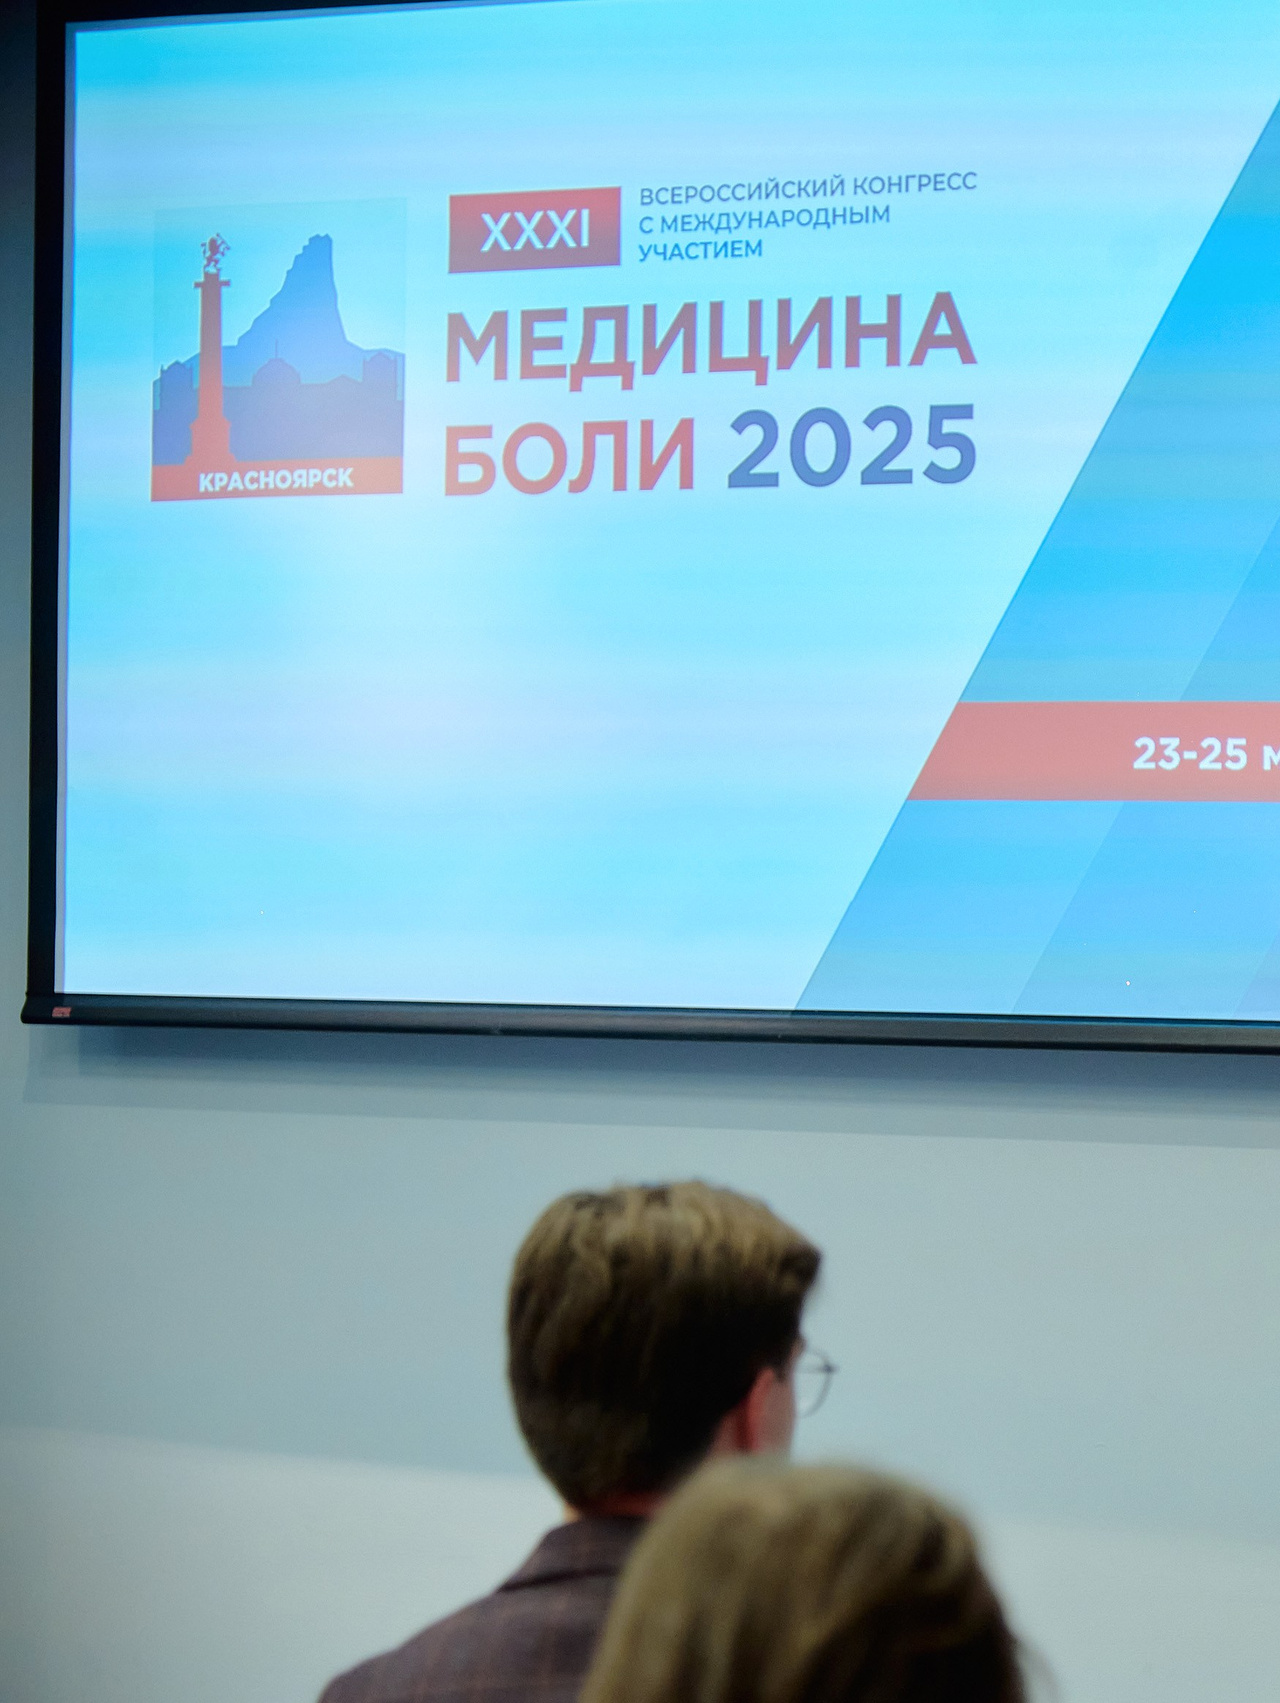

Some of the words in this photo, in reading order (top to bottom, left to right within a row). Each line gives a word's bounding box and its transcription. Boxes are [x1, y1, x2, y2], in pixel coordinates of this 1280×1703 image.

[640, 174, 846, 206] ВСЕРОССИЙСКИЙ
[853, 171, 978, 196] КОНГРЕСС
[479, 208, 591, 255] XXXI
[638, 215, 654, 234] С
[660, 204, 891, 235] МЕЖДУНАРОДНЫМ
[638, 239, 764, 263] УЧАСТИЕМ
[446, 290, 978, 393] МЕДИЦИНА
[445, 417, 695, 497] БОЛИ
[727, 403, 978, 489] 2025
[198, 467, 354, 492] КРАСНОЯРСК
[1132, 737, 1248, 771] 23-25
